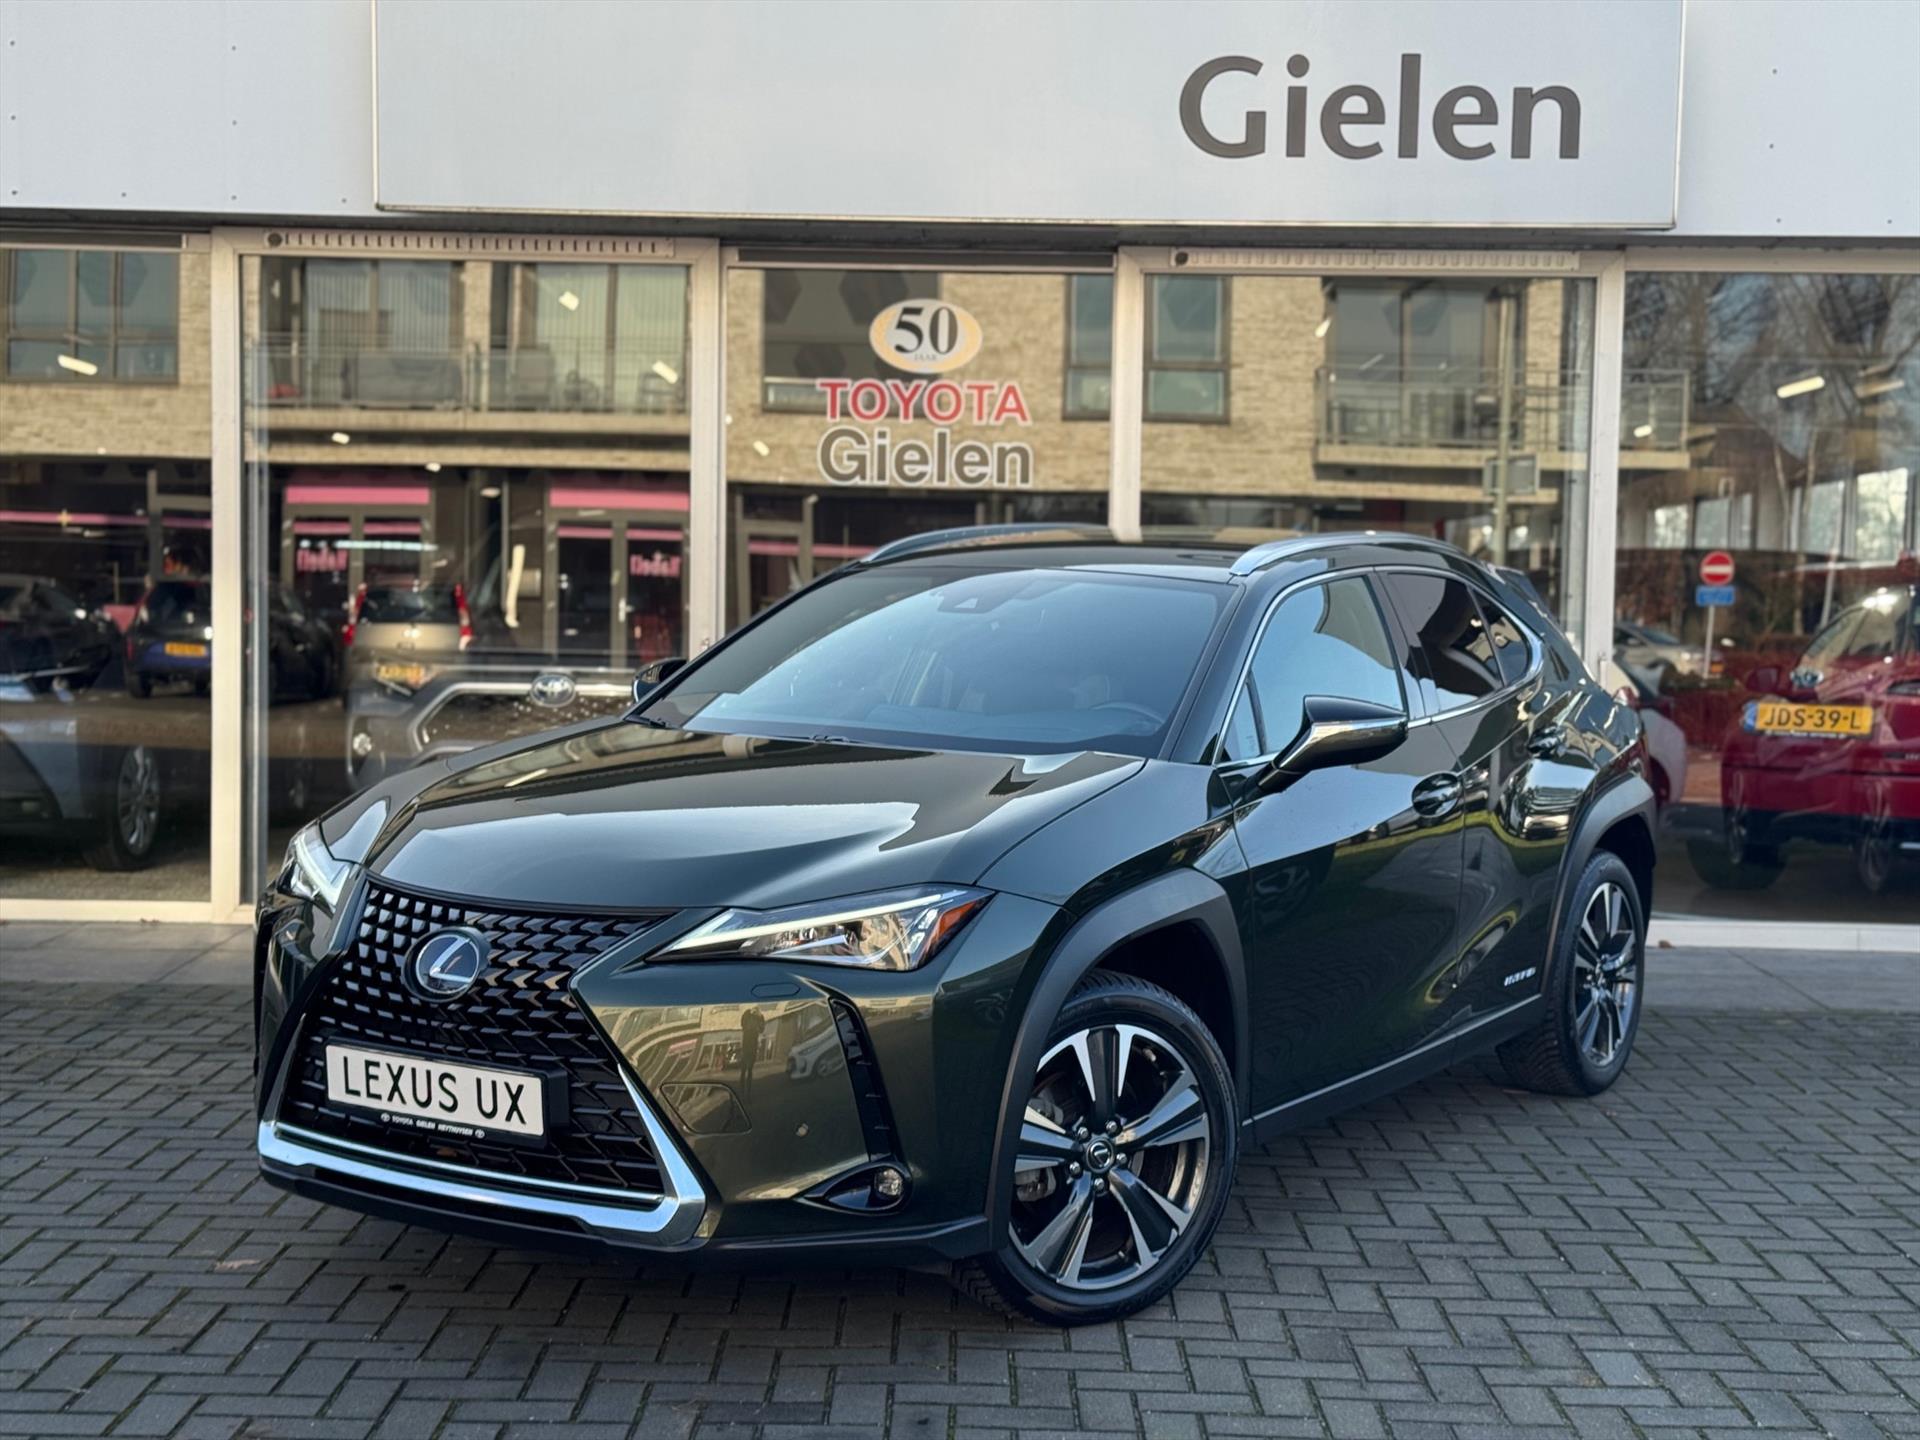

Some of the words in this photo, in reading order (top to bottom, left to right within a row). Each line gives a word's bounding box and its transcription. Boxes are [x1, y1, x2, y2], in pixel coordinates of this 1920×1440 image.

[1178, 53, 1582, 161] Gielen
[893, 305, 959, 355] 50
[817, 381, 1030, 424] TOYOTA
[819, 427, 1031, 485] Gielen
[1763, 706, 1862, 730] JDS-39-L
[342, 1055, 459, 1113] LEXUS
[475, 1076, 527, 1125] UX
[391, 1115, 415, 1126] TOYOTA
